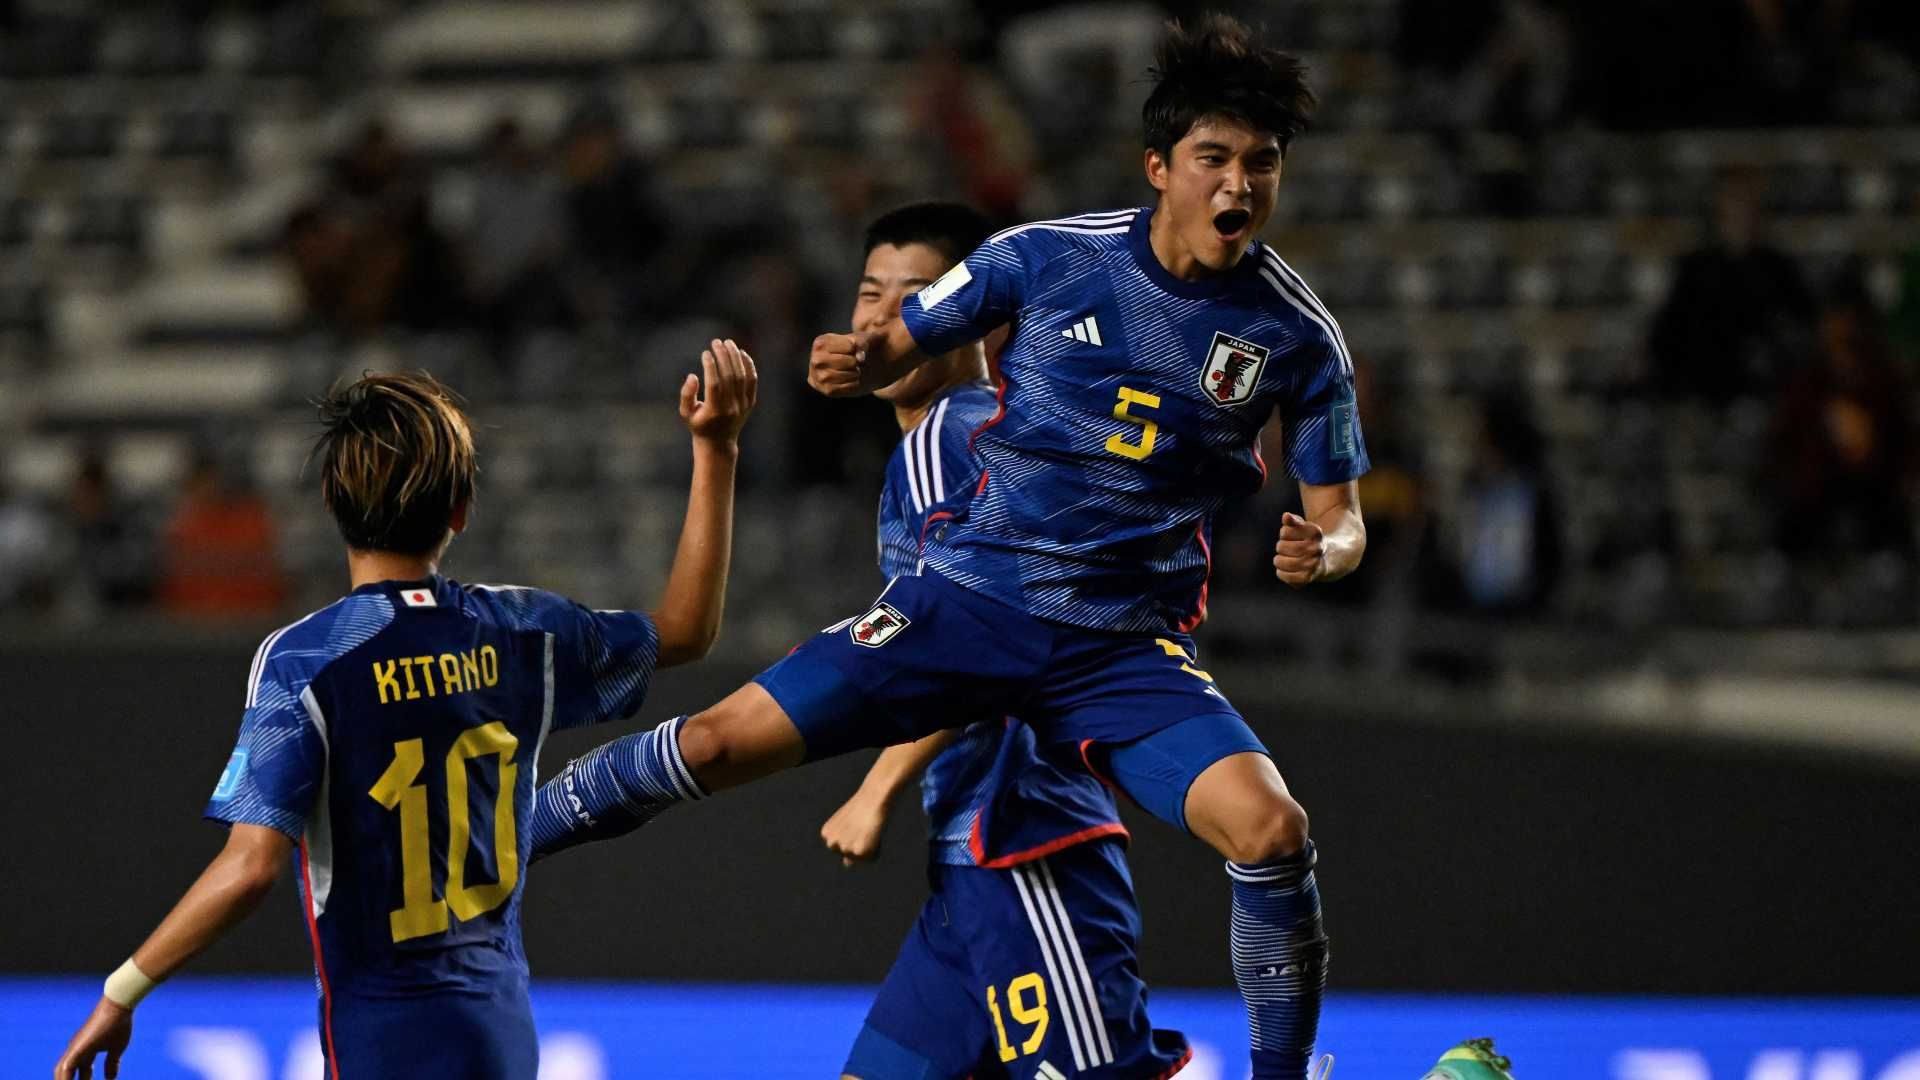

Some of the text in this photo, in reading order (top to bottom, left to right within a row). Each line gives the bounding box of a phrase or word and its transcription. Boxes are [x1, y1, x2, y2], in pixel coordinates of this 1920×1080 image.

[1227, 338, 1256, 354] JAPAN
[1104, 386, 1161, 461] 5
[372, 644, 498, 704] KITANO
[368, 721, 519, 944] 10
[986, 972, 1049, 1063] 19
